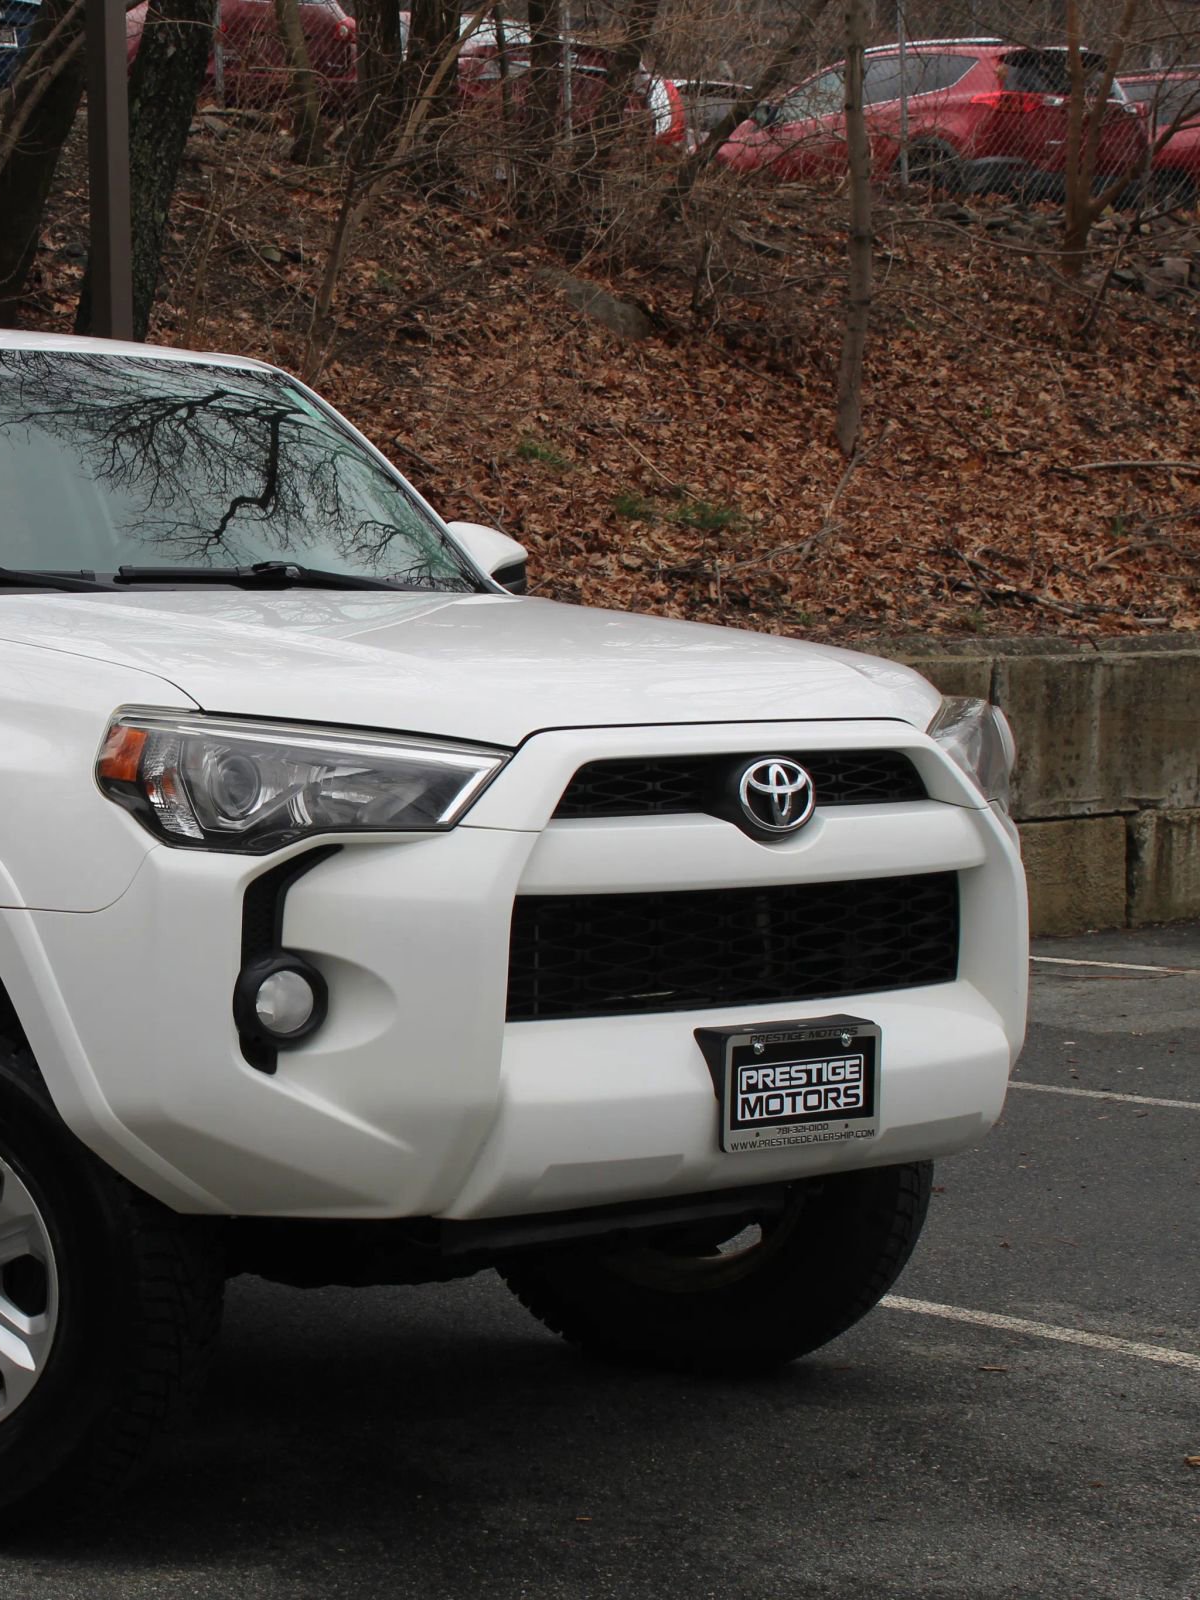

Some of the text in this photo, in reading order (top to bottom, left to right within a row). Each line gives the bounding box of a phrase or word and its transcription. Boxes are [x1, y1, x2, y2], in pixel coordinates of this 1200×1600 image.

[750, 1026, 858, 1044] PRESTIGE MOTORS
[741, 1059, 861, 1092] PRESTIGE
[740, 1084, 861, 1119] MOTORS
[730, 1128, 875, 1151] WWW.PRESTIGEDEALERSHIP.COM
